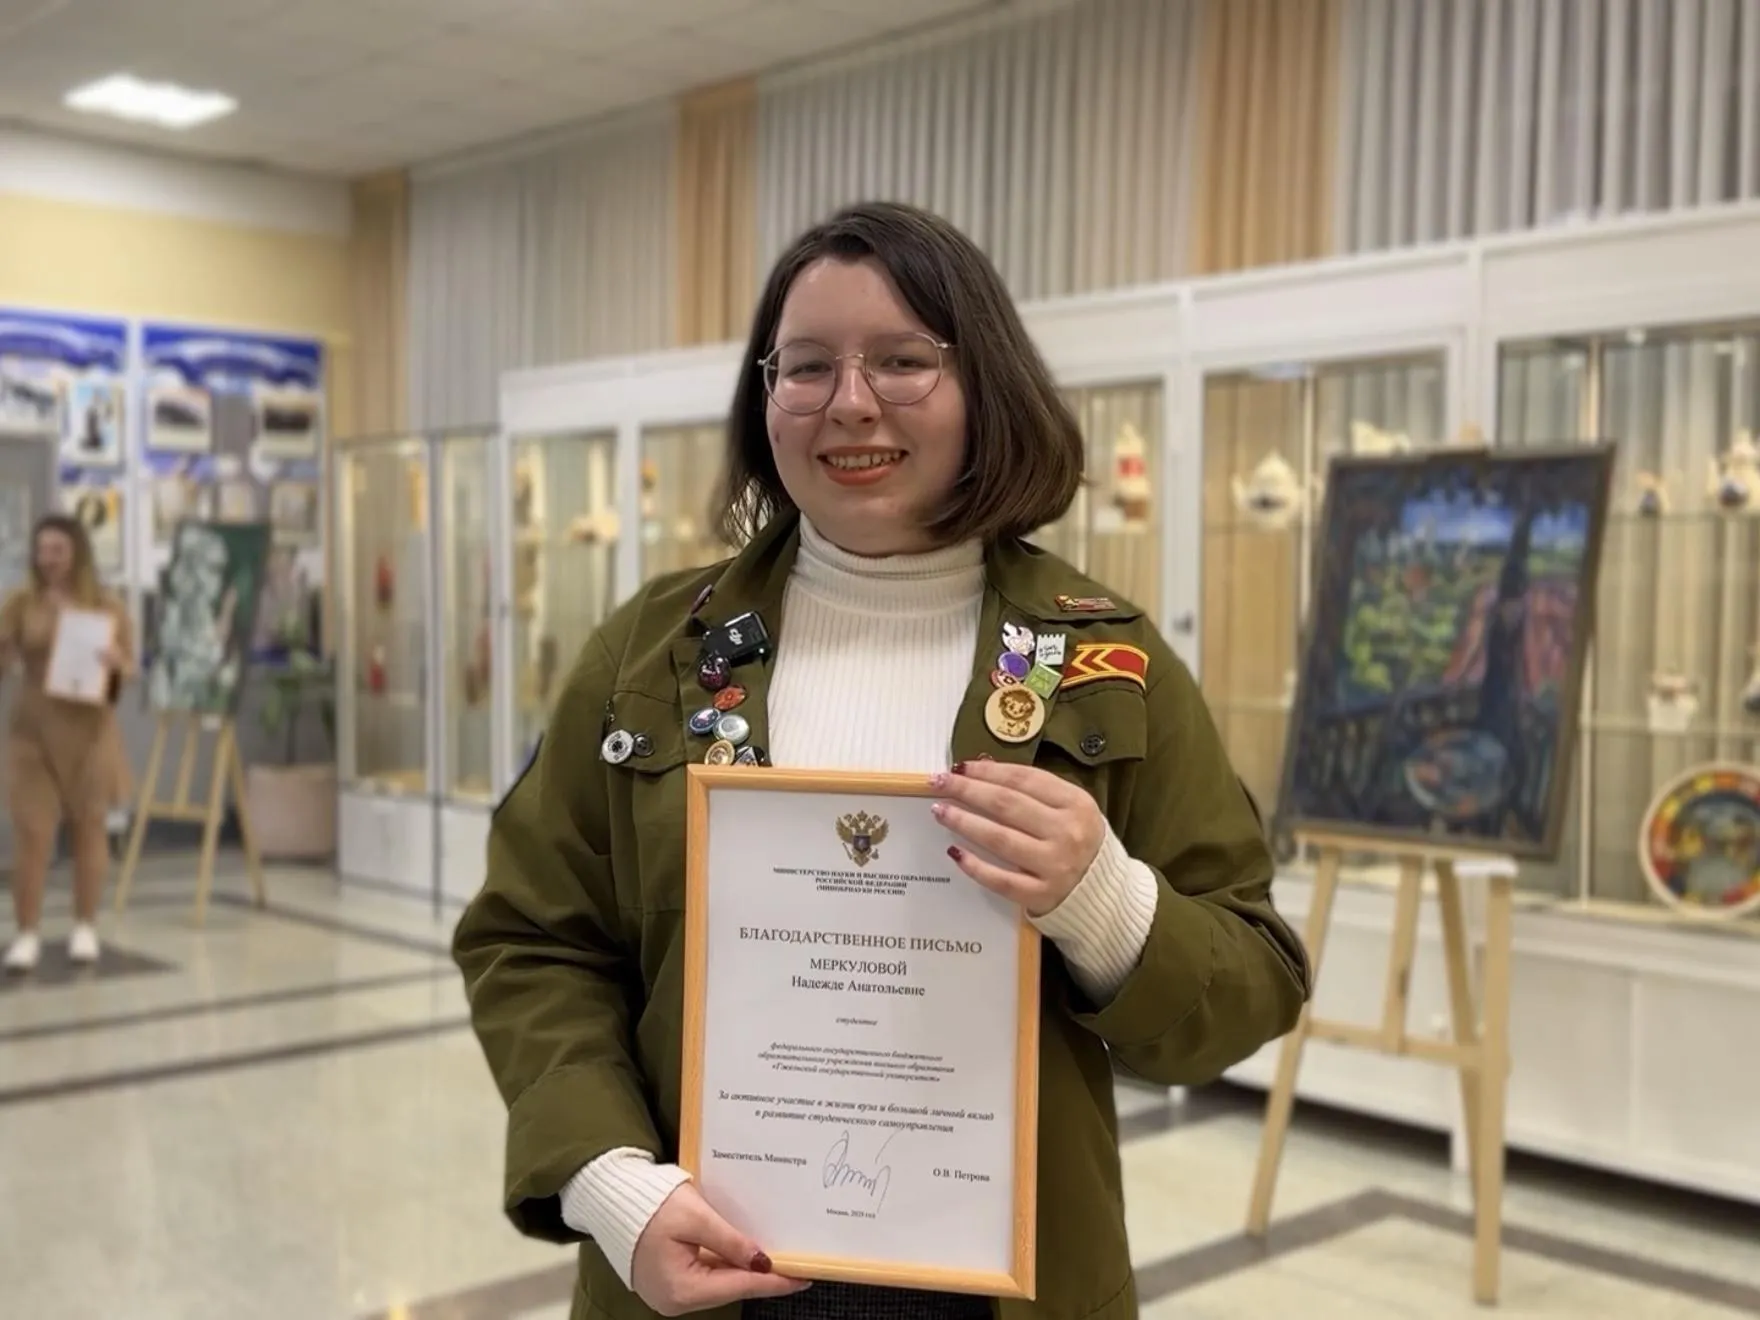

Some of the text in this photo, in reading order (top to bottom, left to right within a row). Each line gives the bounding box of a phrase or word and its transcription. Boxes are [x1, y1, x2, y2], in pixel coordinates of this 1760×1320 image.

[772, 867, 831, 877] МИНИСТЕРСТВО
[863, 872, 900, 880] ВЫСШЕГО
[901, 874, 951, 883] ОБРАЗОВАНИЯ
[815, 877, 907, 888] РОССИЙСКОЙ ФЕДЕРАЦИИ
[816, 886, 905, 896] (МИНОБРНАУКИ РОССИИ)
[739, 927, 983, 954] БЛАГОДАРСТВЕННОЕ ПИСЬМО
[810, 958, 907, 976] МЕРКУЛОВОЙ
[791, 975, 926, 996] Надежде Анатольевне
[758, 1052, 825, 1063] образовательного
[770, 1042, 943, 1062] федерального государственного бюджетного
[719, 1090, 729, 1100] За
[731, 1092, 775, 1104] активное
[777, 1096, 815, 1107] участие
[825, 1101, 855, 1110] жизни
[857, 1103, 878, 1113] вуза
[888, 1103, 928, 1116] большой
[931, 1107, 965, 1119] личный
[967, 1110, 995, 1121] вклад
[762, 1110, 805, 1121] развитие
[808, 1113, 876, 1126] студенческого
[878, 1119, 954, 1133] самоуправления
[712, 1149, 807, 1166] Заместитель Министра
[954, 1170, 991, 1183] Петрова
